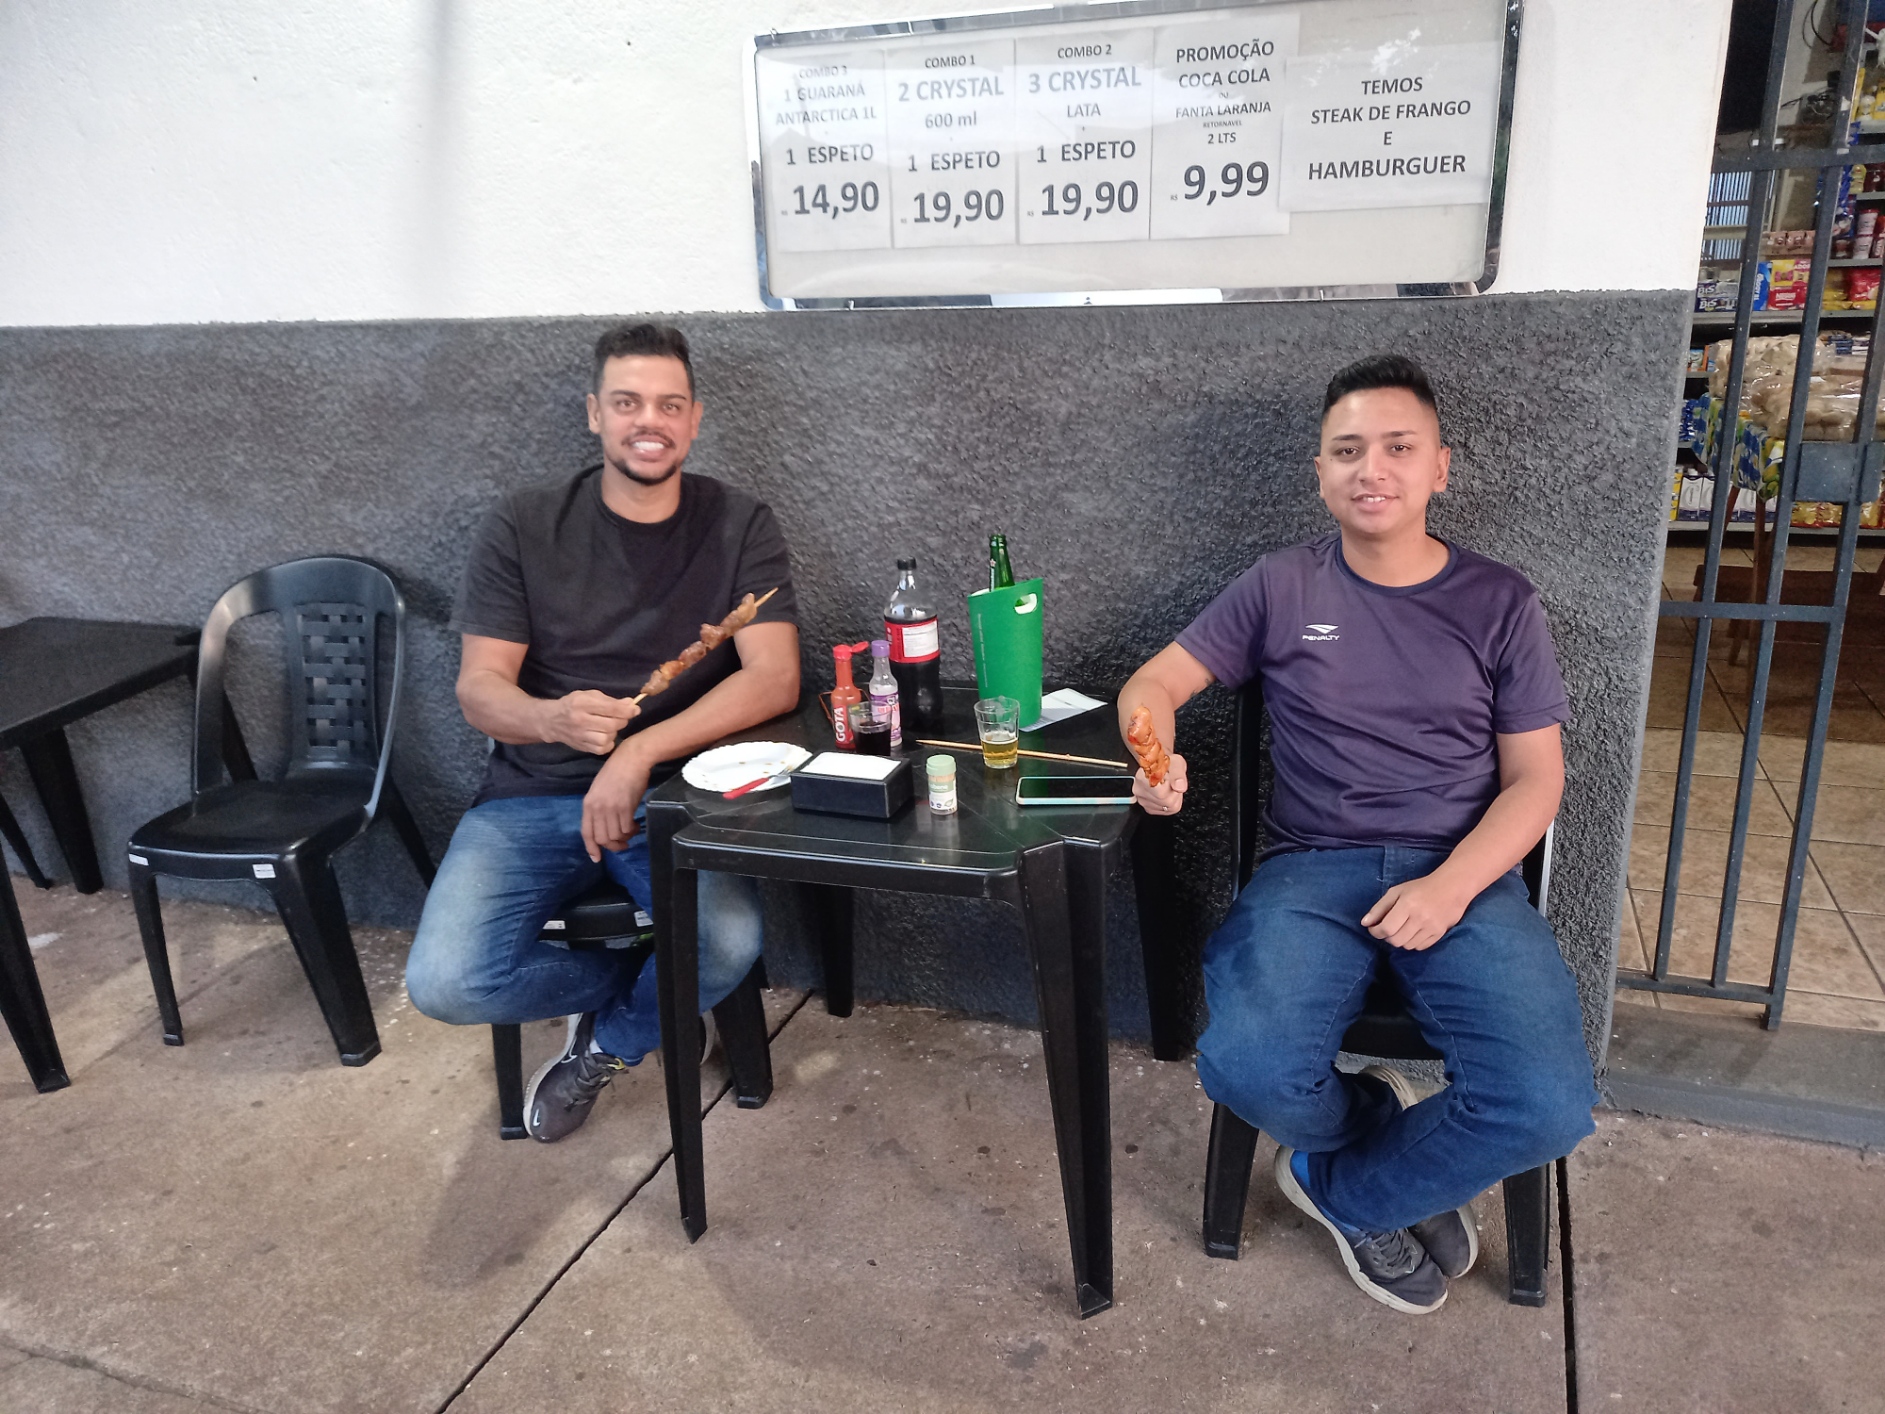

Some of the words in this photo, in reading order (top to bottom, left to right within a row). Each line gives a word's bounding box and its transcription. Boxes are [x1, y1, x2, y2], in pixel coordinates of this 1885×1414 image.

[924, 55, 966, 69] COMBO
[970, 54, 975, 65] 1
[1057, 45, 1102, 59] COMBO
[1105, 44, 1112, 55] 2
[1176, 38, 1275, 63] PROMOÇÃO
[799, 66, 838, 79] COMBO
[1028, 73, 1041, 94] 3
[1048, 65, 1142, 92] CRYSTAL
[1179, 71, 1223, 88] COCA
[1227, 67, 1271, 85] COLA
[785, 89, 791, 102] 1
[898, 82, 910, 102] 2
[916, 75, 1004, 101] CRYSTAL
[1361, 76, 1423, 95] TEMOS
[776, 107, 858, 125] ANTARCTICA
[863, 106, 877, 120] 1L
[925, 112, 953, 129] 600
[958, 110, 977, 126] ml
[1067, 103, 1101, 118] LATA
[1175, 105, 1214, 118] FANTA
[1217, 101, 1272, 116] LARANJA
[1311, 107, 1363, 124] STEAK
[1369, 105, 1391, 121] DE
[1396, 100, 1471, 119] FRANGO
[1208, 133, 1214, 144] 2
[1218, 132, 1237, 144] LTS
[1383, 131, 1393, 145] E
[786, 148, 796, 165] 1
[808, 143, 873, 164] ESPETO
[908, 154, 917, 172] 1
[931, 150, 1000, 171] ESPETO
[1037, 145, 1047, 163] 1
[1061, 140, 1136, 162] ESPETO
[1308, 154, 1466, 180] HAMBURGUER
[1184, 161, 1269, 206] 9,99
[793, 180, 879, 220] 14,90
[914, 189, 1004, 229] 19,90
[1042, 180, 1139, 221] 19,90
[834, 707, 846, 742] GOTA
